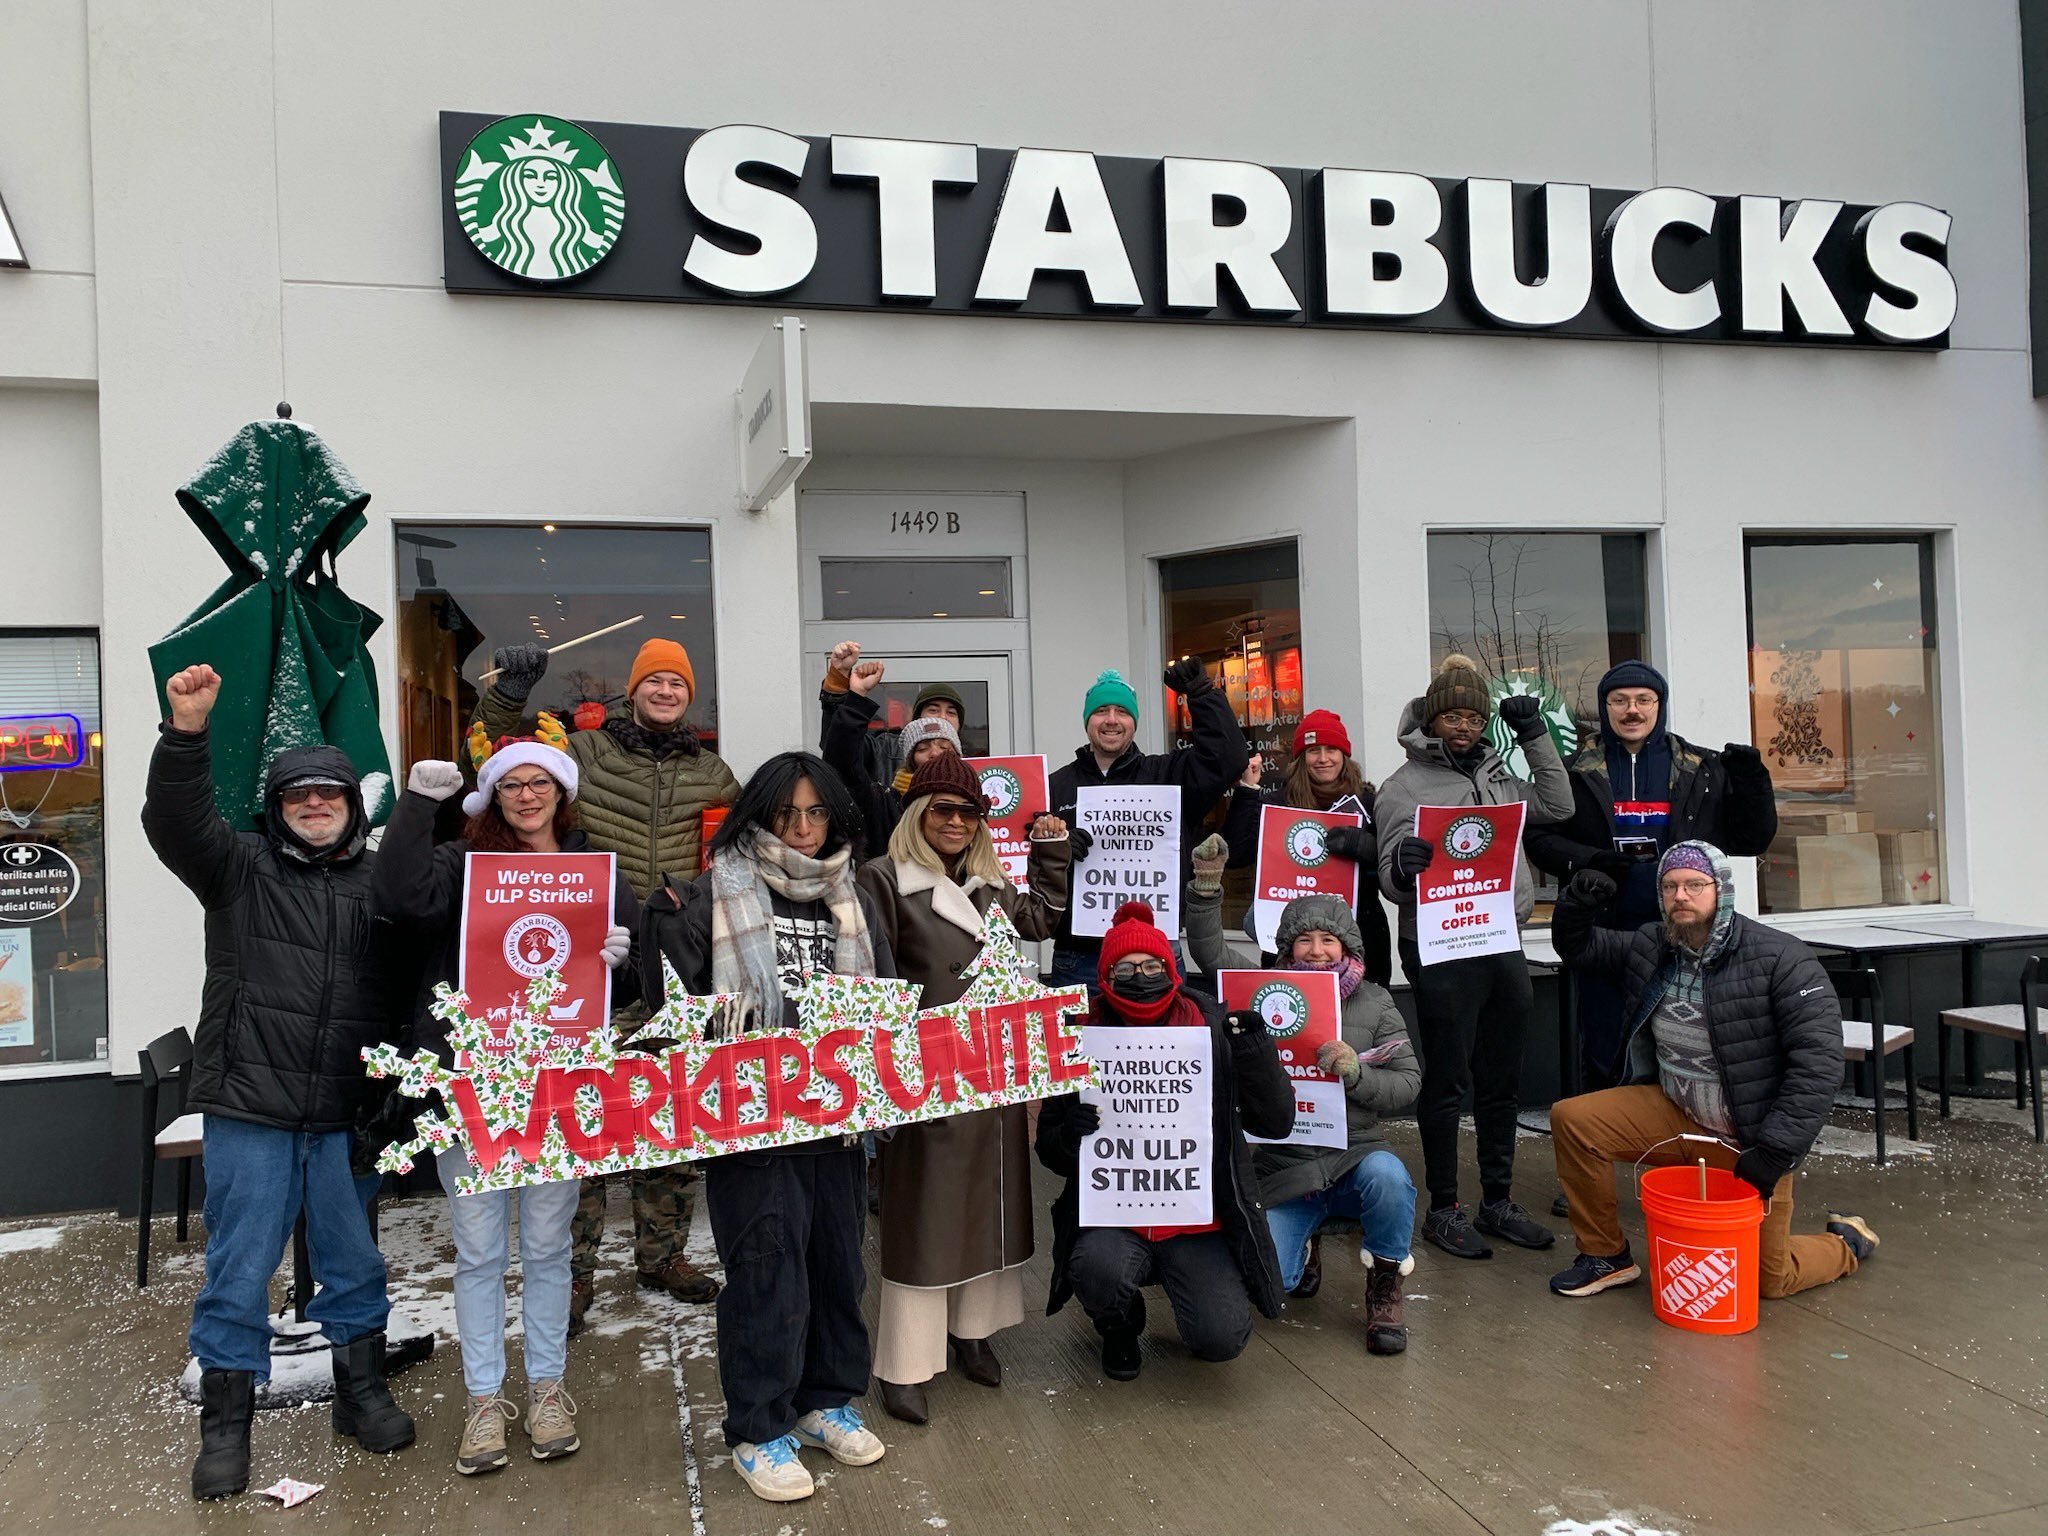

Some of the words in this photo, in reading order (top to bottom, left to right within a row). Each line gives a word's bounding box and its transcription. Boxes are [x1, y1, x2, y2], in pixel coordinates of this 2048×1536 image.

[683, 124, 1958, 343] STARBUCKS
[891, 511, 938, 534] 1449
[946, 512, 960, 533] B
[0, 725, 73, 761] PEN
[979, 768, 1016, 783] TARBUCKS
[1084, 810, 1173, 822] STARBUCKS
[1091, 825, 1165, 836] WORKERS
[1101, 839, 1154, 850] UNITED
[0, 870, 33, 880] terilize
[34, 869, 47, 878] all
[48, 868, 68, 878] Kits
[497, 870, 554, 885] We're
[559, 872, 584, 884] on
[1085, 868, 1117, 886] ON
[1124, 870, 1167, 887] ULP
[1296, 875, 1317, 888] NO
[1454, 868, 1475, 881] NO
[0, 888, 20, 896] ame
[22, 885, 48, 895] Level
[485, 888, 524, 903] ULP
[528, 888, 593, 903] Strike!
[1427, 878, 1502, 899] CONTRACT
[0, 901, 28, 912] edical
[29, 900, 57, 910] Clinic
[1455, 901, 1474, 914] NO
[512, 918, 564, 937] STARBUCKS
[1441, 913, 1490, 931] COFFEE
[508, 940, 537, 974] WORKERS
[1257, 983, 1302, 1002] STARBUCKS
[1286, 1007, 1306, 1037] UNITED
[551, 1035, 581, 1048] Slay
[452, 1029, 864, 1173] WORKERS
[873, 994, 1089, 1113] UNITE
[1101, 1079, 1193, 1094] WORKERS
[1113, 1098, 1180, 1113] UNITED
[1312, 1122, 1335, 1130] UNITED
[1094, 1137, 1134, 1160] ON
[1144, 1139, 1197, 1161] ULP
[1091, 1167, 1201, 1192] STRIKE
[1664, 1252, 1694, 1279] THE
[1661, 1249, 1736, 1314] HOME
[1685, 1275, 1735, 1319] DEPOT
